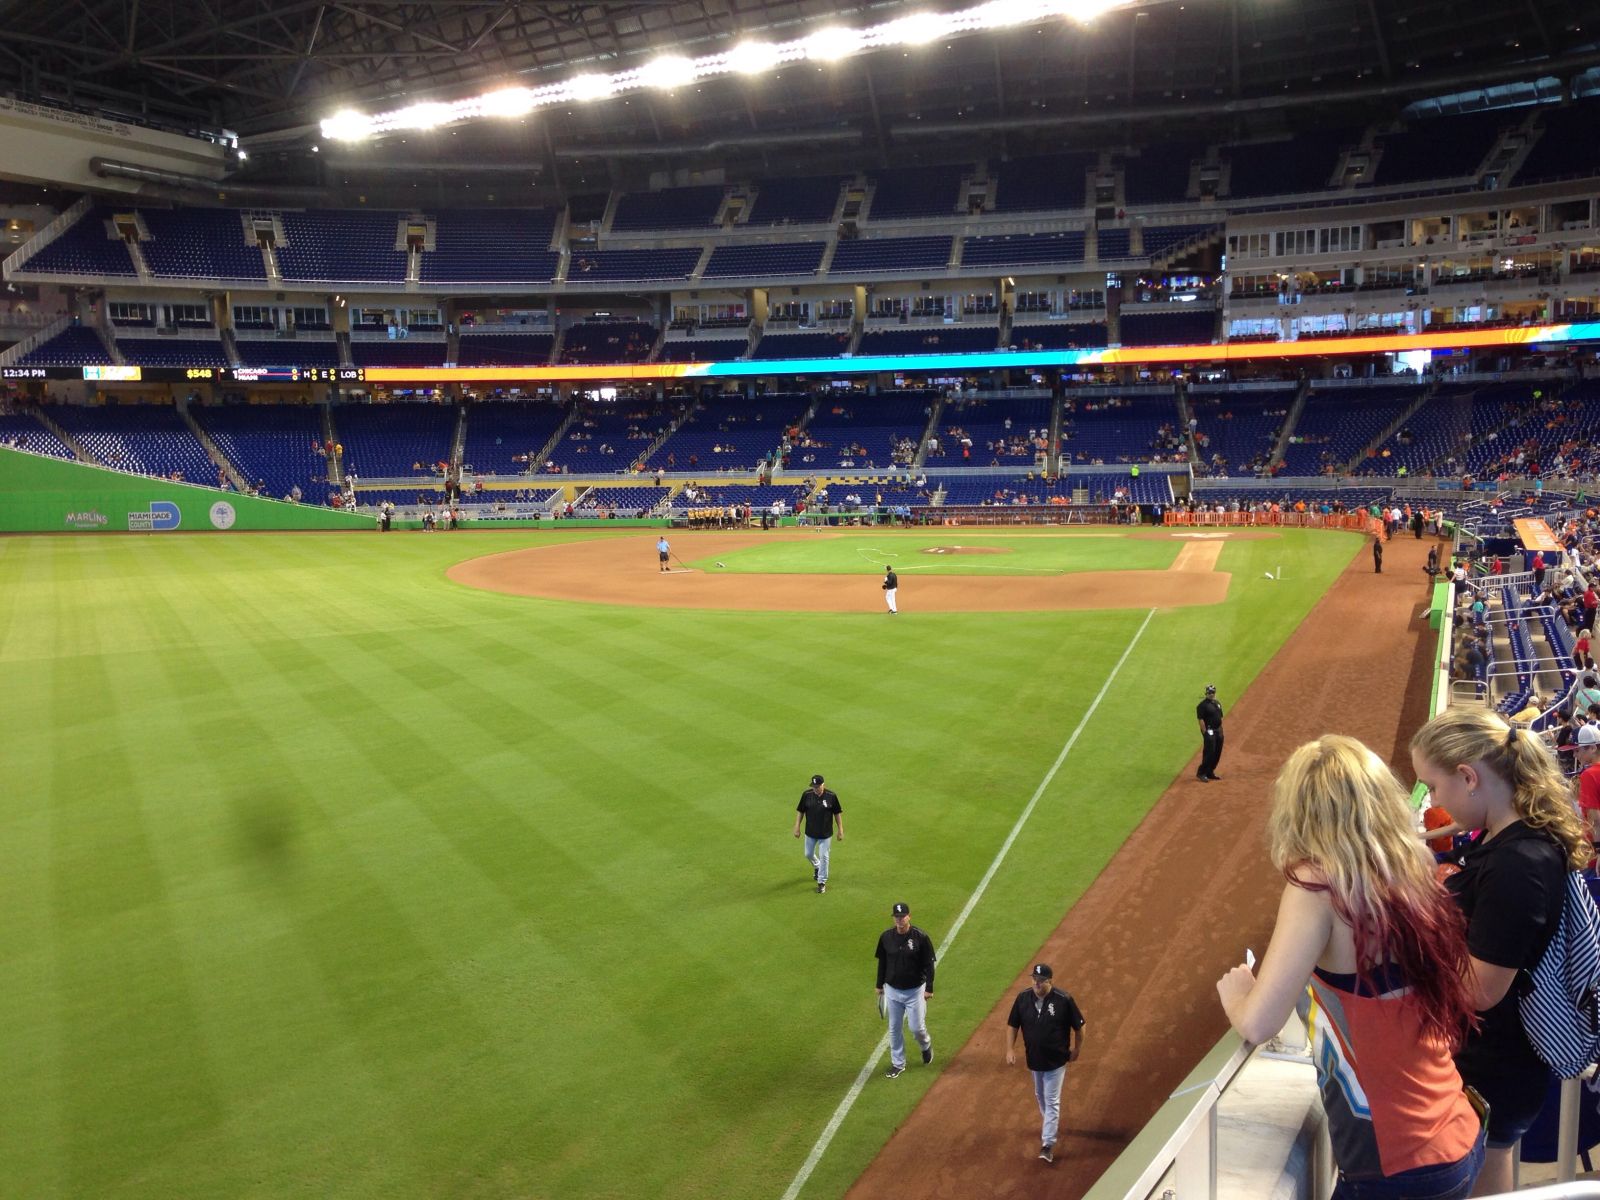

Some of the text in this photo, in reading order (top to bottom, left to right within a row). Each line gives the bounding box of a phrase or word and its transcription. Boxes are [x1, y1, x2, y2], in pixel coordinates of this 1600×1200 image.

[3, 369, 46, 377] 12:34 PM
[303, 370, 311, 378] H
[321, 370, 328, 379] E
[340, 370, 357, 379] LOB
[66, 510, 108, 525] MARLINS
